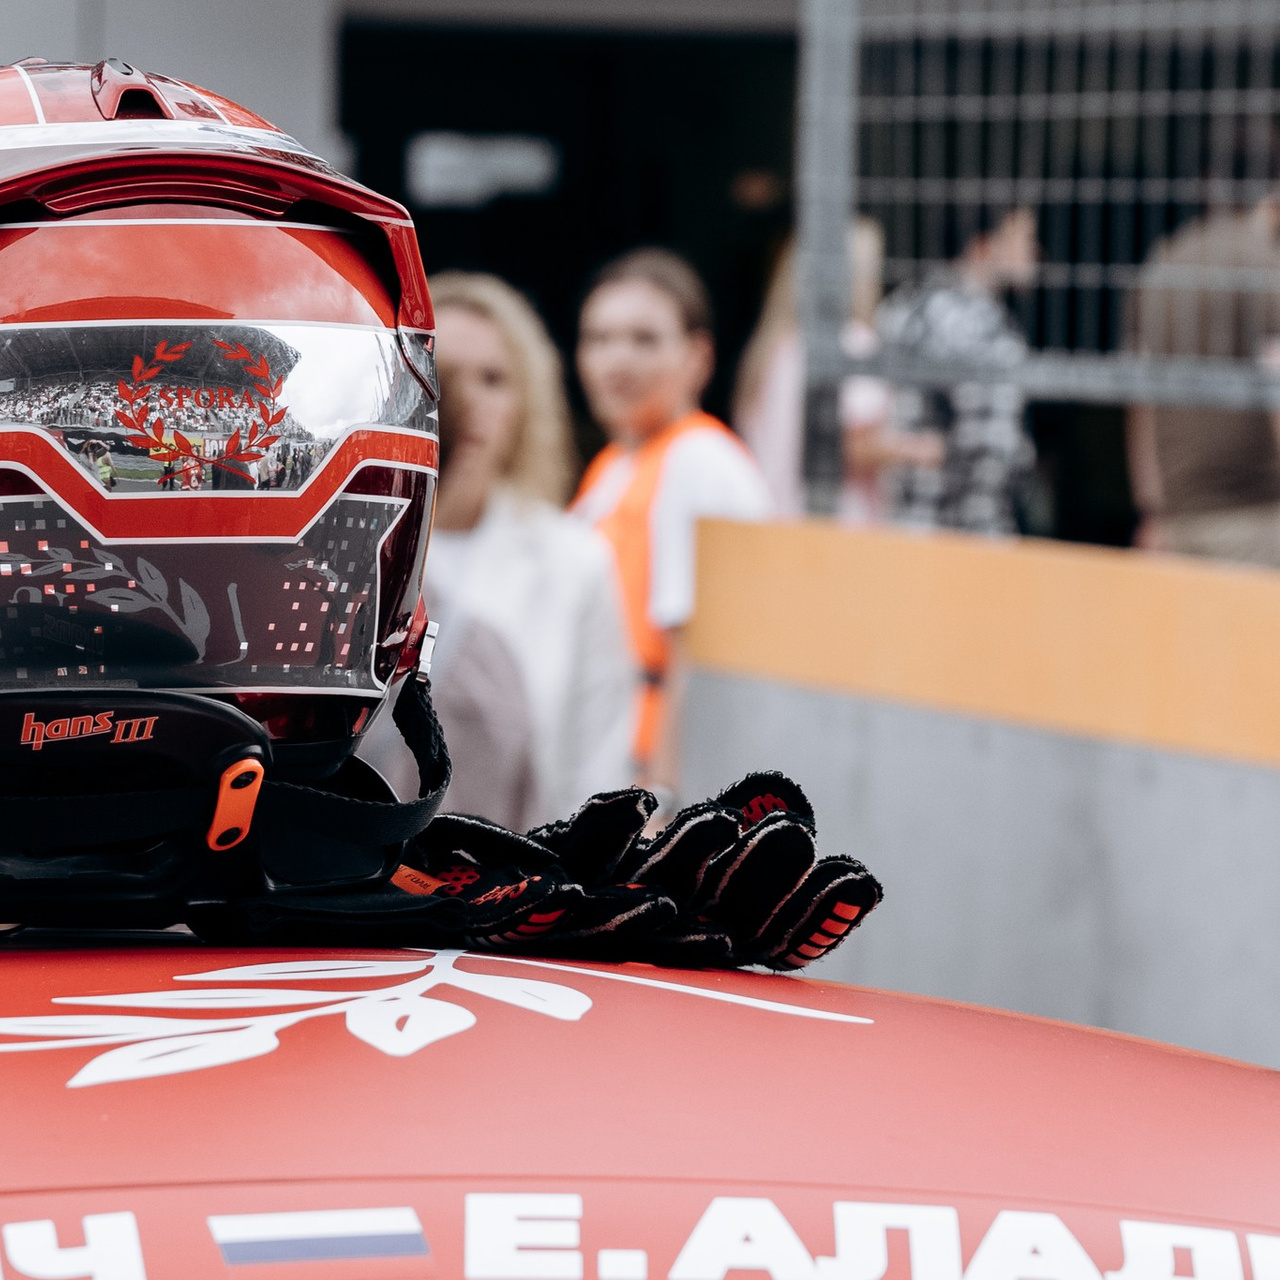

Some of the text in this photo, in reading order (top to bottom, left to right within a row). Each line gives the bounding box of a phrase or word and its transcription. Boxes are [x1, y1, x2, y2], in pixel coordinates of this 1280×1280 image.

[159, 386, 257, 409] SPORA
[20, 710, 160, 750] hans III
